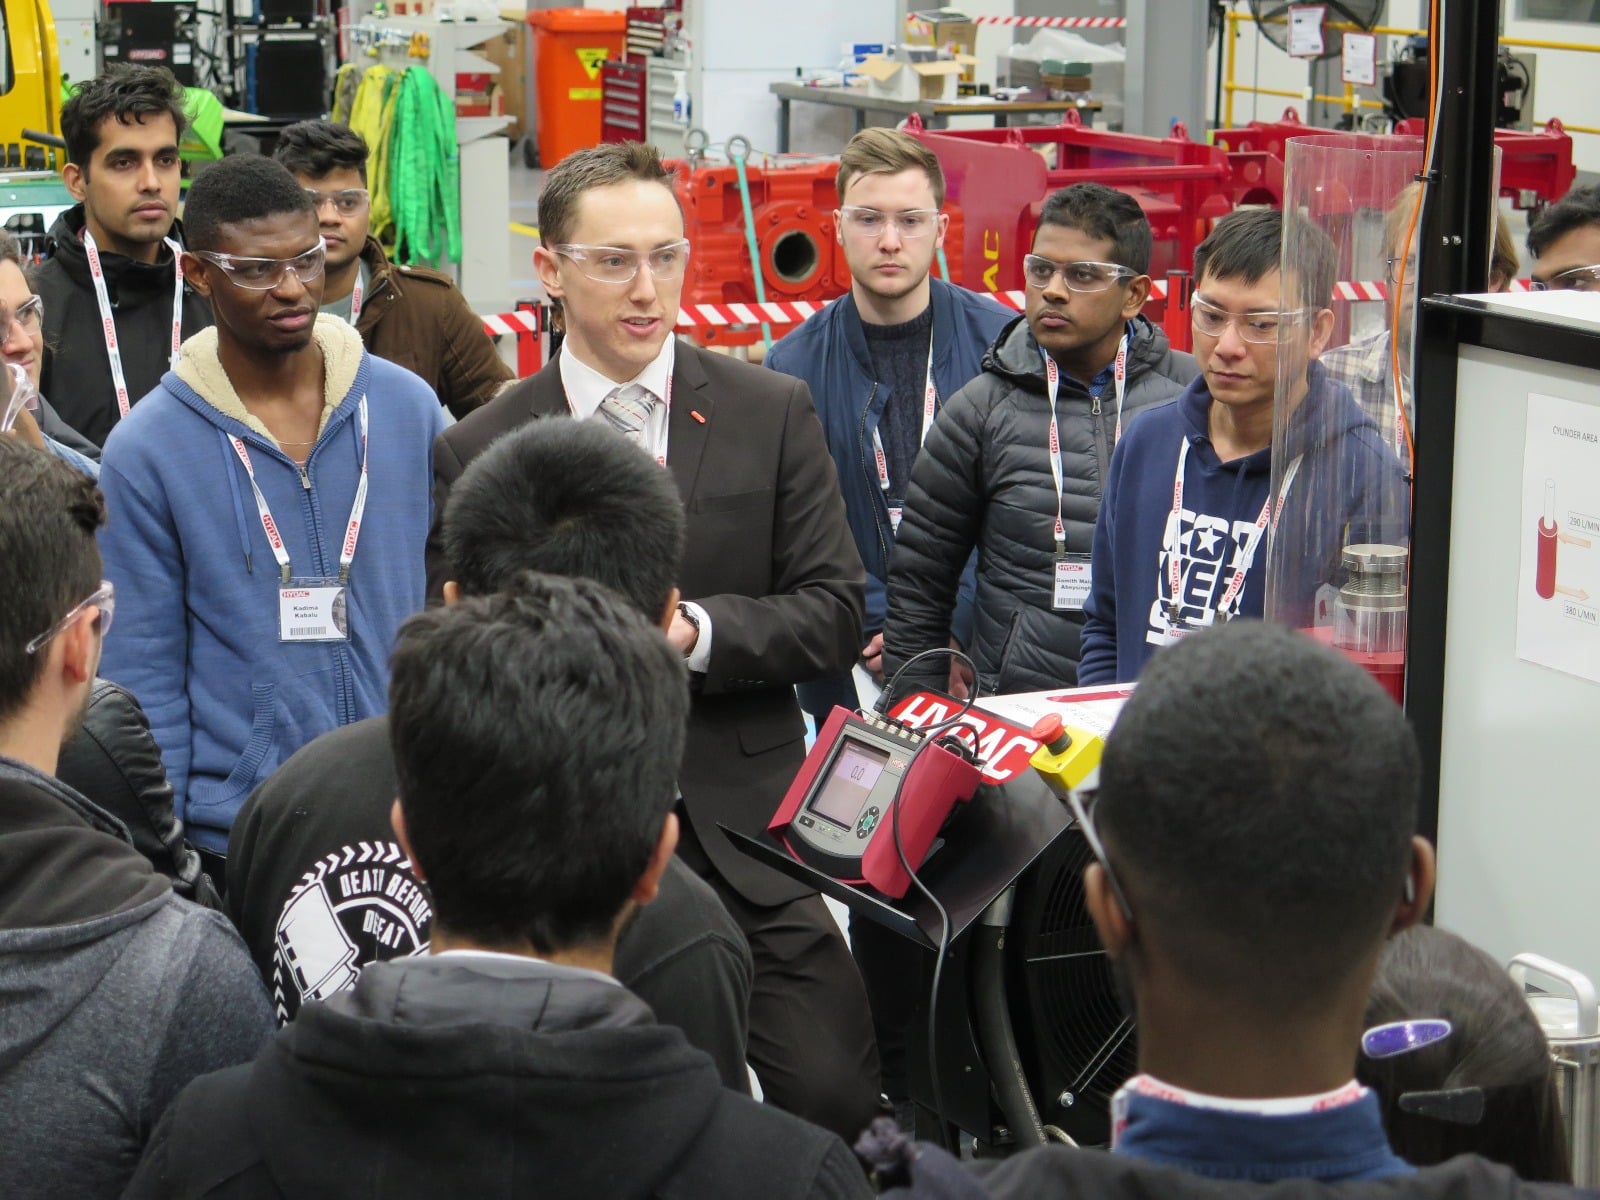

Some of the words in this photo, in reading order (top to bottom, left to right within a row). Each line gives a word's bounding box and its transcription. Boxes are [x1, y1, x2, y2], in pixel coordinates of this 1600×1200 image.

[1116, 352, 1125, 380] HYDAC
[1552, 425, 1581, 440] CYLINDER
[1582, 432, 1598, 443] AREA
[876, 450, 886, 478] HYDAC
[1174, 481, 1182, 514] HYDAC
[263, 515, 281, 549] HYDAC
[345, 521, 359, 555] HYDAC
[1569, 516, 1580, 526] 290
[1581, 520, 1600, 532] L/MIN
[282, 590, 310, 598] HYDAC
[1225, 571, 1243, 603] HYDAC
[1565, 605, 1576, 616] 380
[1577, 609, 1596, 622] L/MIN
[896, 695, 1038, 780] HYDAC
[851, 765, 865, 780] 0.0
[385, 874, 433, 929] BEFORE
